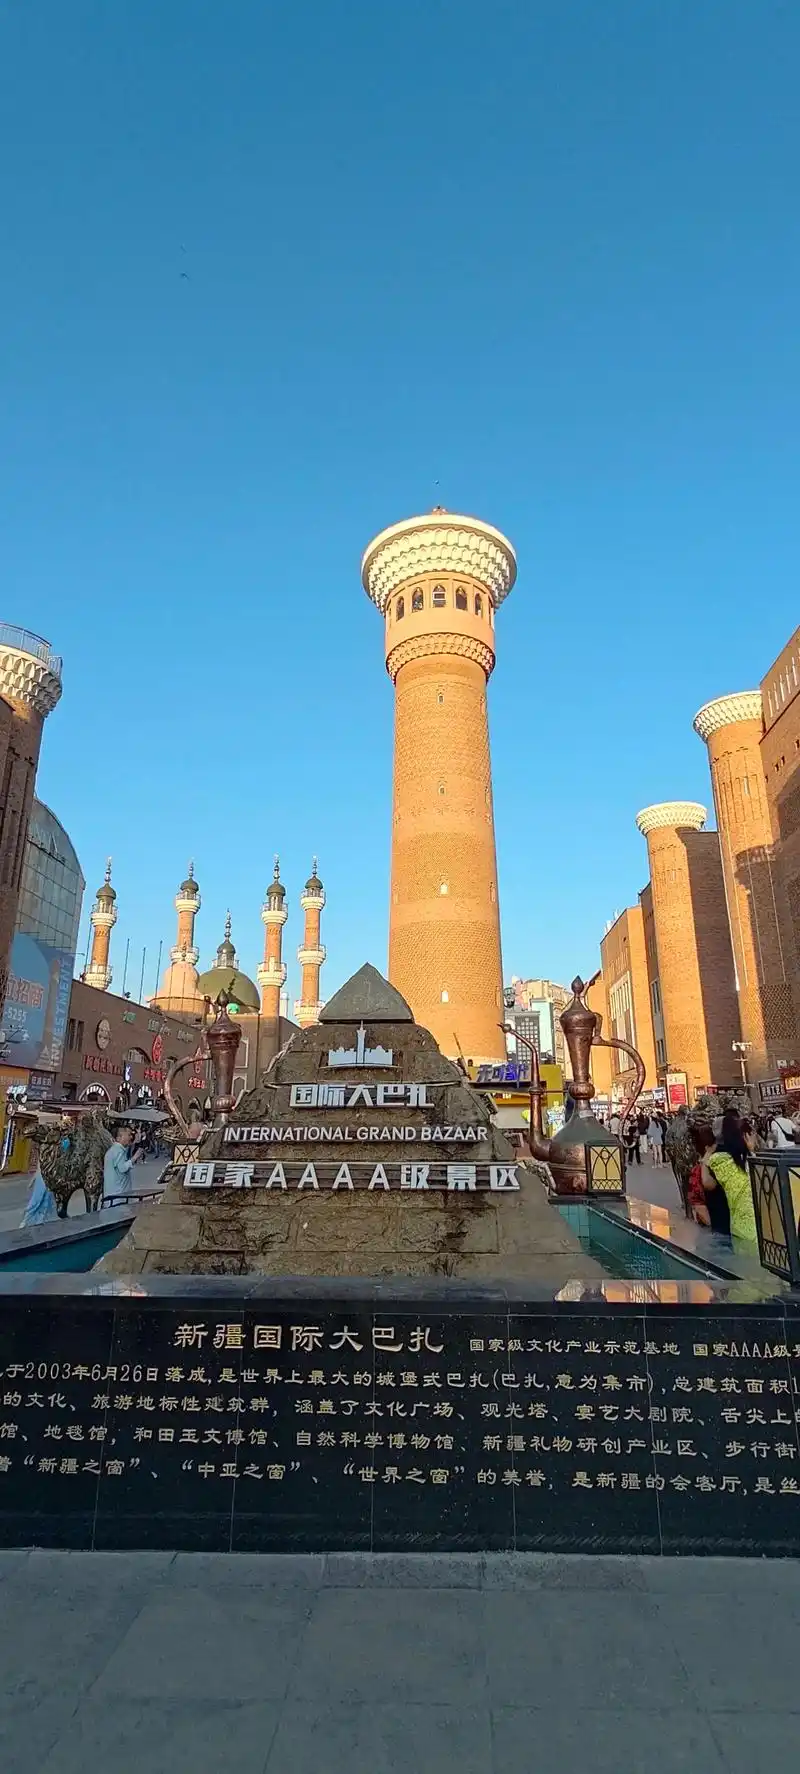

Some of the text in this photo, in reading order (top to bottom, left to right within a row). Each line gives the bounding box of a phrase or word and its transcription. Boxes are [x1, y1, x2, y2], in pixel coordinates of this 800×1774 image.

[289, 1084, 434, 1107] 国际大巴扎
[224, 1126, 488, 1142] INTERNATIONAL GRAND BAZAAR
[183, 1161, 520, 1191] 国家AAAA级景区
[173, 1322, 444, 1353] 新疆国际大巴扎
[469, 1338, 681, 1356] 国家级文化产业示范基地
